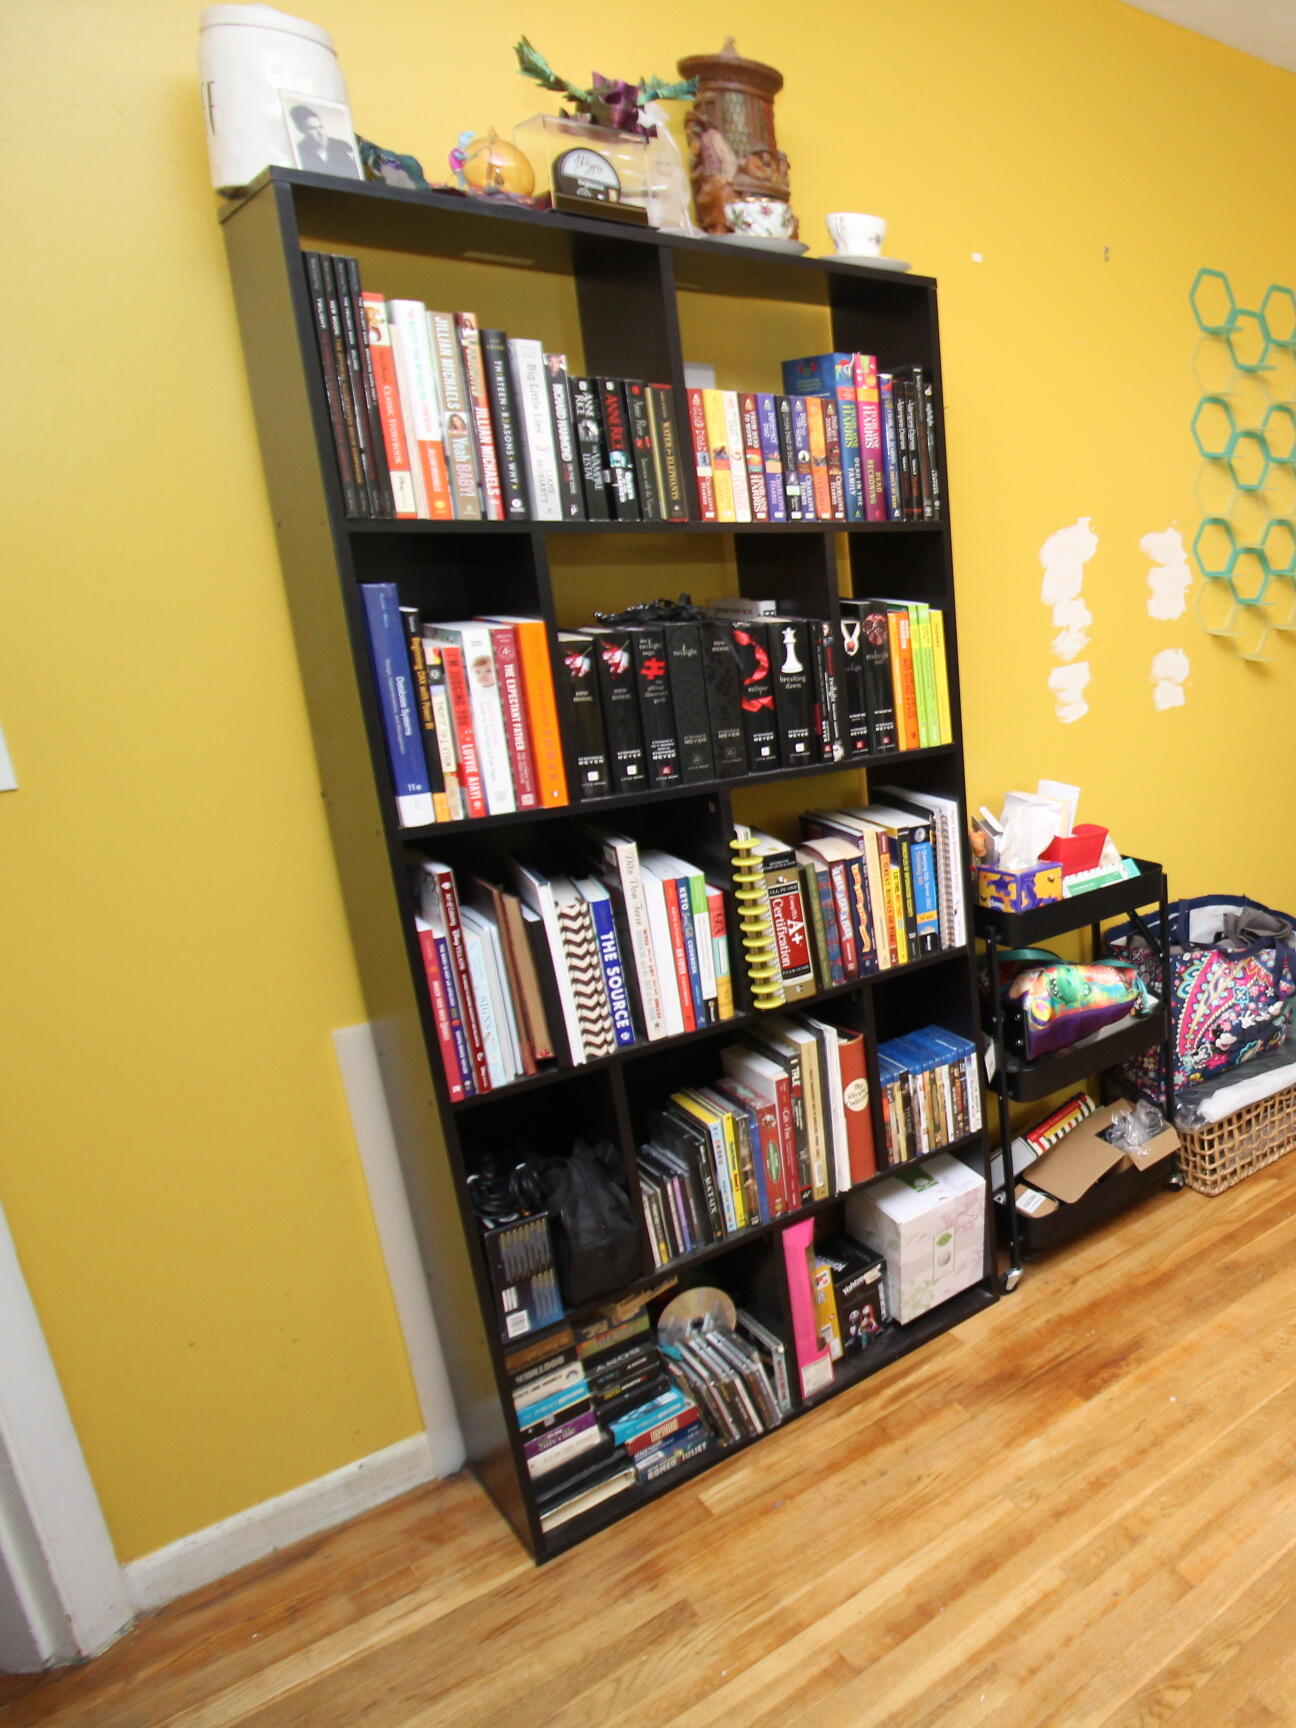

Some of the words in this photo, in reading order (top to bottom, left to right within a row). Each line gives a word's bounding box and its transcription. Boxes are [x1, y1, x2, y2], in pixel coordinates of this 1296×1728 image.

[435, 318, 453, 356] JILLIAN
[441, 359, 461, 410] MICHAELS
[526, 364, 538, 381] Big
[528, 383, 542, 411] Little
[551, 383, 568, 418] RICHARD
[574, 394, 586, 416] RICE
[582, 392, 597, 418] ANNE
[604, 394, 619, 426] ANNE
[474, 406, 492, 444] JILLIAN
[532, 414, 544, 434] Lies
[662, 420, 675, 449] WATER
[748, 411, 758, 431] FROM
[841, 404, 855, 449] HARRIS
[862, 405, 876, 450] HARRIS
[869, 405, 881, 450] CHARLAINE
[452, 437, 468, 462] Yeah
[556, 418, 574, 462] HAMMOND
[609, 427, 625, 450] RICE
[455, 464, 476, 498] BABY!
[480, 445, 500, 496] MICHAELS
[508, 463, 519, 484] WHY
[666, 456, 682, 502] ELEPHANTS
[847, 467, 857, 497] FAMILY
[852, 457, 862, 479] DEAD
[866, 459, 879, 505] RECKONING
[874, 471, 883, 493] DEAD
[699, 483, 711, 506] HARRIS
[702, 476, 714, 513] CHARLAINE
[749, 474, 765, 514] HARRIS
[854, 480, 862, 491] IN
[856, 491, 864, 507] THE
[415, 671, 428, 689] DAX
[503, 663, 516, 678] THE
[395, 676, 407, 708] Database
[505, 678, 521, 723] EXPECTANT
[399, 708, 412, 736] Systems
[420, 703, 433, 722] Power
[513, 723, 526, 752] FATHER
[718, 731, 740, 739] MEYER
[754, 735, 774, 743] MEYER
[462, 743, 477, 774] LUVVIE
[466, 776, 481, 801] AJAYI
[678, 886, 690, 911] KETO
[686, 939, 698, 974] COOKBOOK
[771, 898, 791, 968] Certification
[787, 919, 805, 945] A+
[600, 931, 616, 962] THE
[605, 966, 632, 1029] SOURCE
[790, 1065, 801, 1088] TRUE
[645, 1458, 678, 1481] ROMEO
[681, 1442, 708, 1464] JULIET
